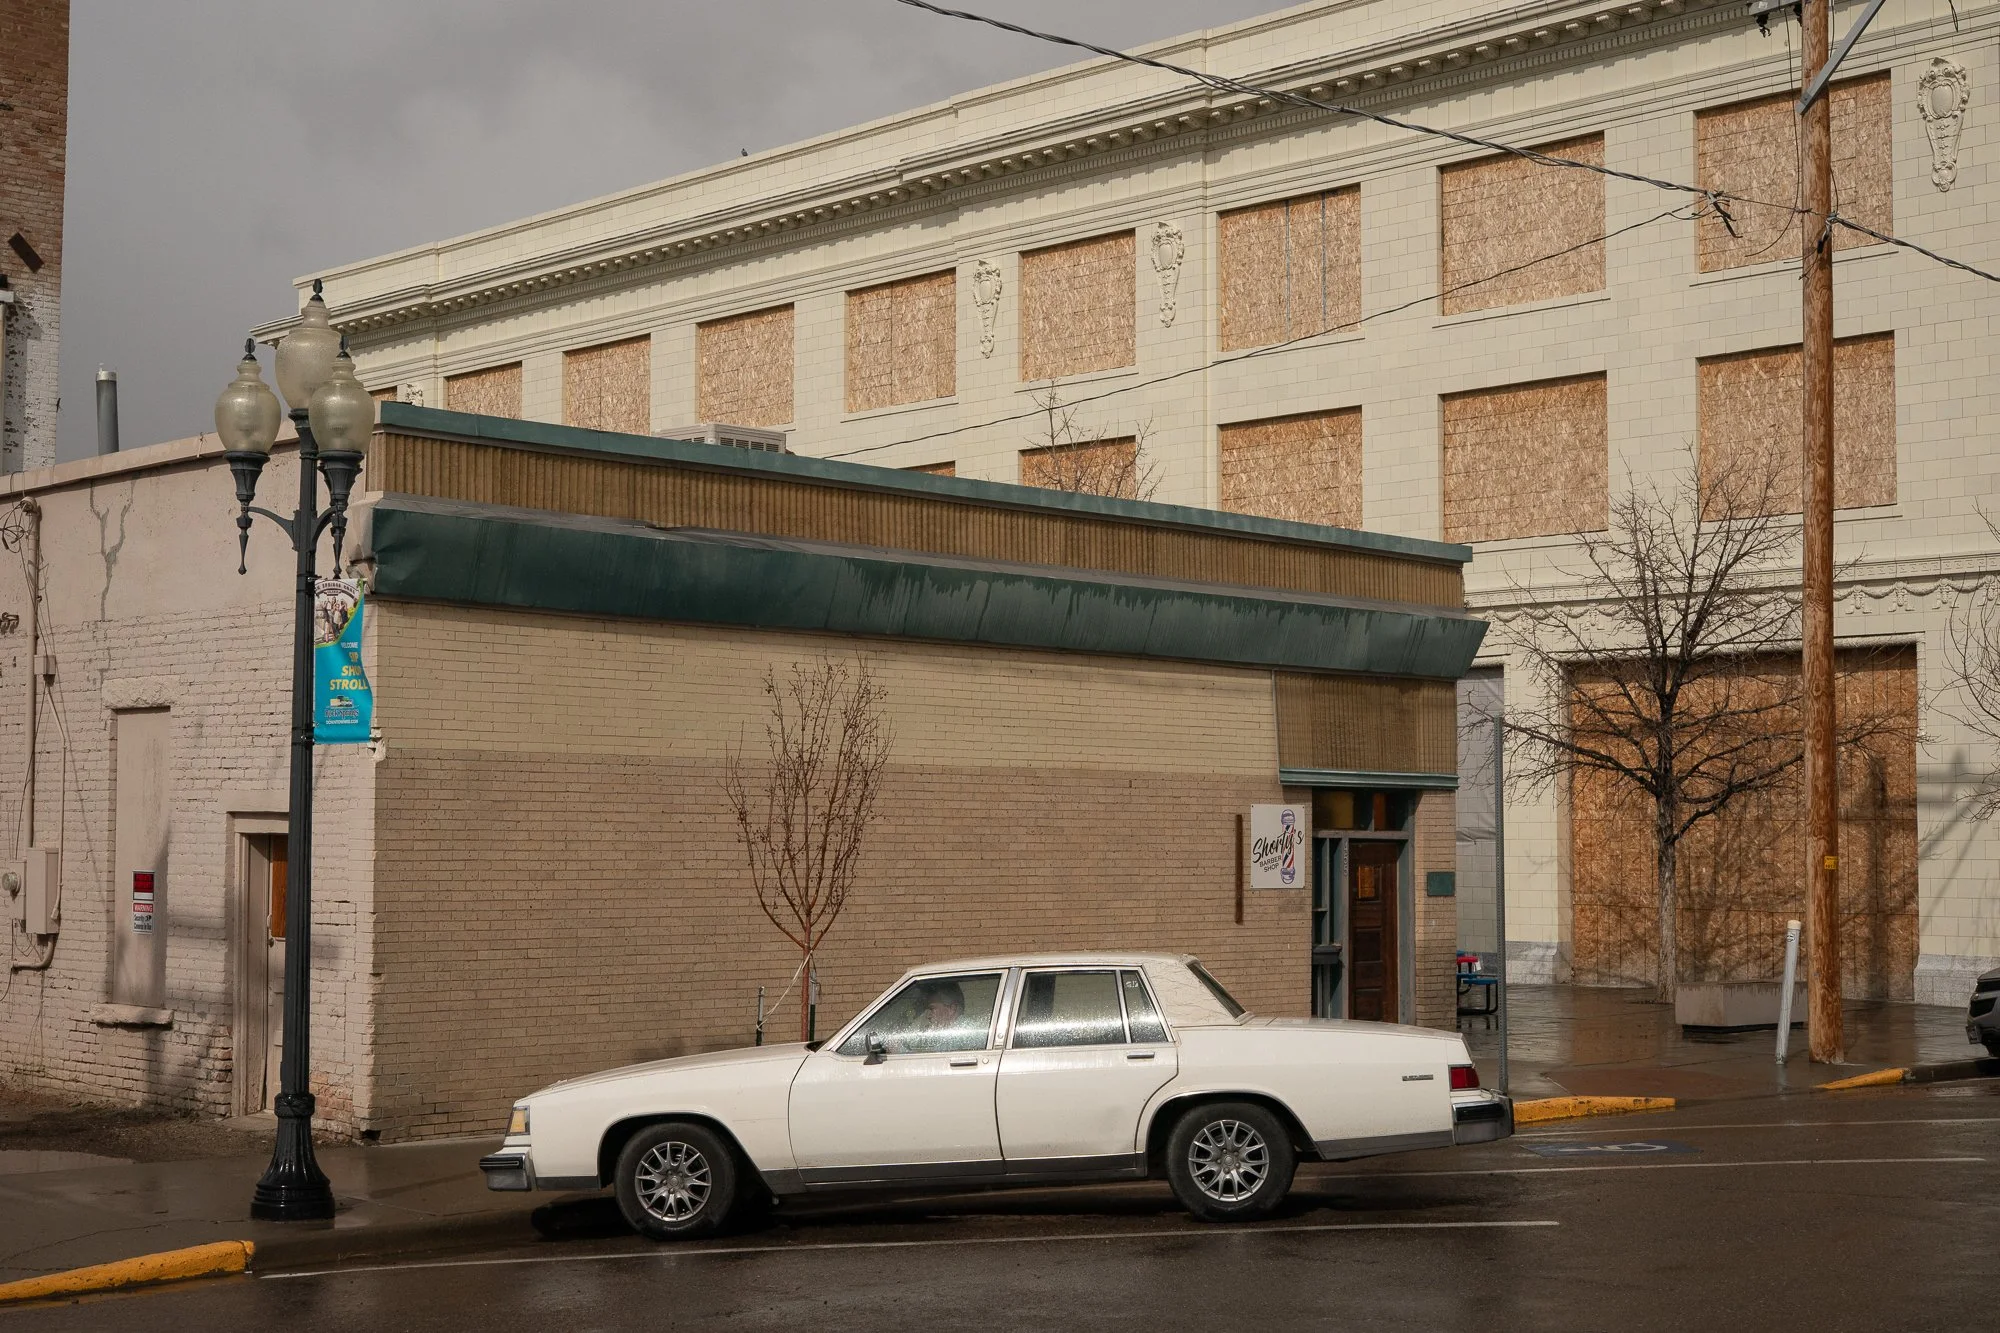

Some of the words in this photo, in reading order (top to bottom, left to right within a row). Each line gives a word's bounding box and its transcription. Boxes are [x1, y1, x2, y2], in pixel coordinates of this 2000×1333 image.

[342, 666, 361, 676] SHO
[330, 679, 368, 690] STROLL
[1252, 829, 1304, 863] Shorty's
[1259, 855, 1282, 868] BARBER
[1264, 863, 1279, 873] SHOP
